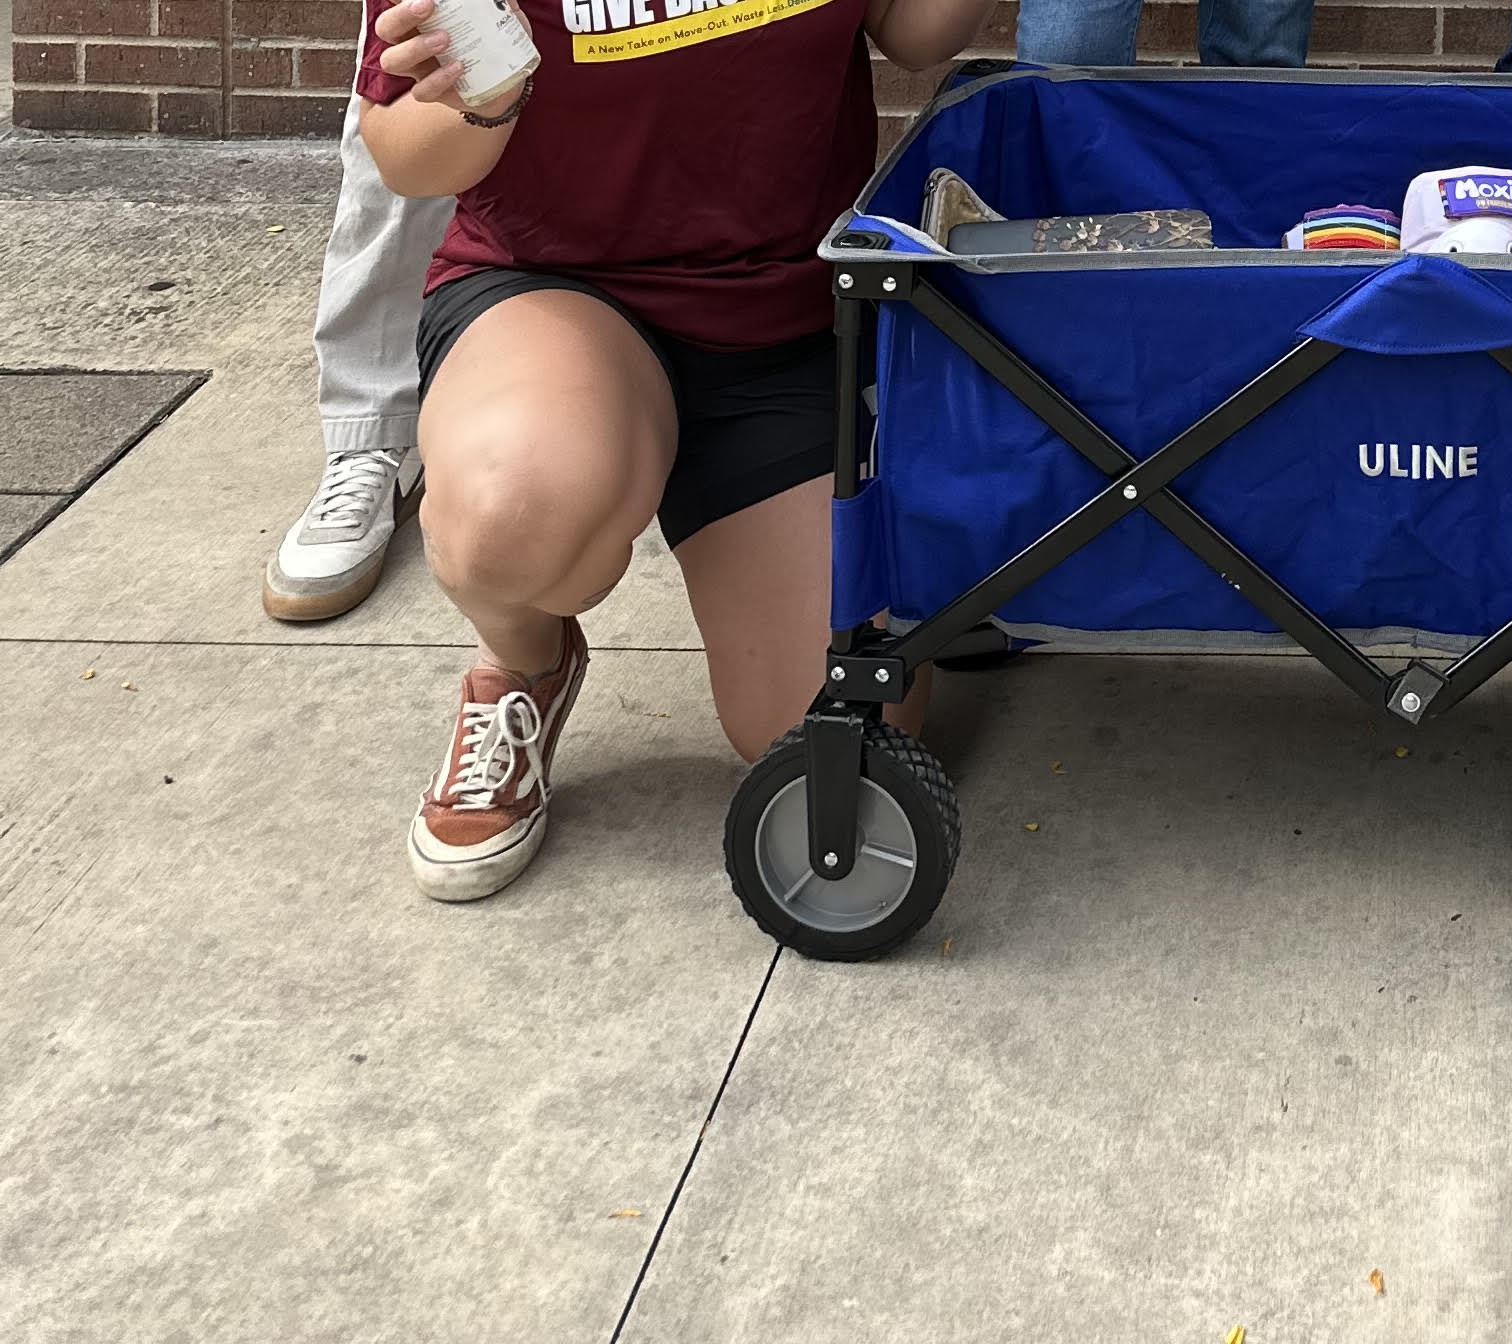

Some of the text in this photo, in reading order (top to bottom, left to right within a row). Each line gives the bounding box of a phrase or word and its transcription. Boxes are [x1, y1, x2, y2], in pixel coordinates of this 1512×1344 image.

[588, 45, 596, 54] A
[599, 44, 624, 54] New
[627, 38, 655, 50] Take
[658, 35, 671, 44] on
[732, 9, 764, 23] Waste
[1359, 443, 1478, 480] ULINE
